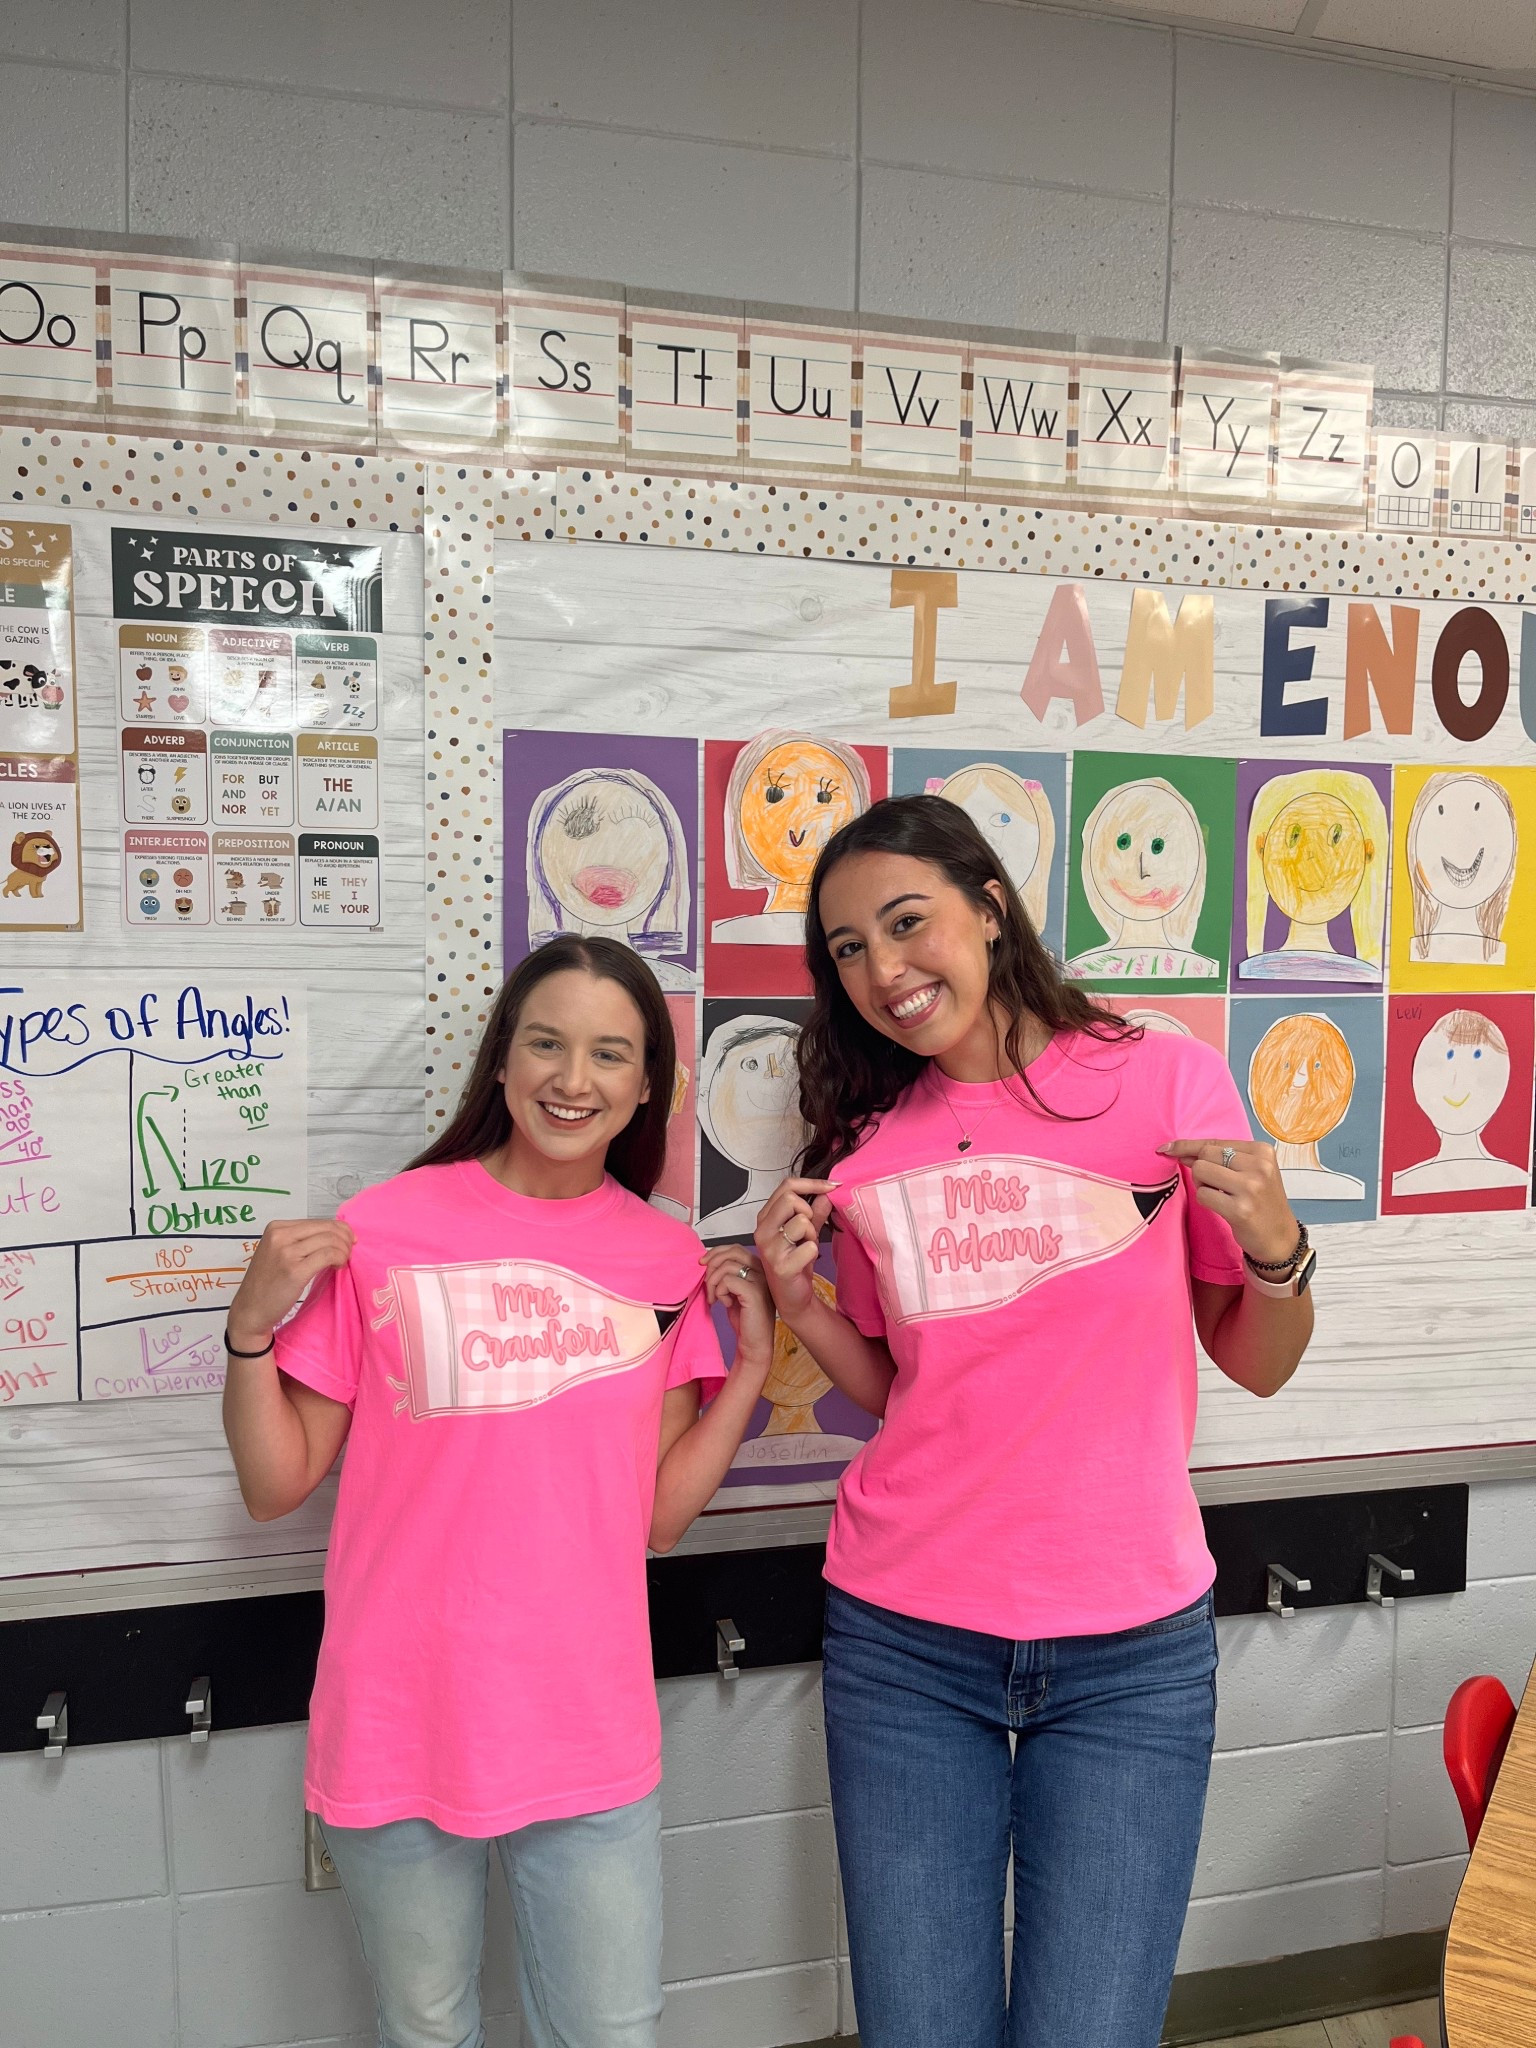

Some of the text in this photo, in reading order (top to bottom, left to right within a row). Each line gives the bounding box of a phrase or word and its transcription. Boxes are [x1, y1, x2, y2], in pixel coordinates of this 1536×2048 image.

[0, 282, 76, 348] Oo
[139, 291, 207, 389] Pp
[261, 305, 355, 404] Qq
[409, 318, 470, 384] Rr
[537, 330, 592, 393] Ss
[657, 345, 713, 407] Tt
[770, 356, 832, 419] Uu
[886, 367, 940, 428] Vv
[983, 377, 1059, 439] Ww
[1095, 388, 1152, 447] Xx
[1201, 394, 1250, 478] Yy
[1300, 406, 1346, 463] Zz
[12, 557, 50, 569] SPECIFIC
[173, 546, 298, 573] PARTS OF
[133, 570, 337, 617] SPEECH
[17, 625, 39, 634] COW
[41, 627, 49, 635] IS
[146, 632, 178, 643] NOUN
[222, 637, 282, 649] ADJECTIVE
[323, 642, 350, 652] VERB
[889, 569, 1536, 743] I AM ENO
[144, 735, 185, 746] ADVERB
[214, 737, 290, 749] CONJUNCTION
[317, 741, 360, 752] ARTICLE
[222, 773, 245, 784] FOR
[258, 775, 279, 785] BUT
[323, 777, 353, 793] THE
[222, 789, 246, 799] AND
[261, 790, 278, 800] OR
[8, 802, 29, 810] LION
[31, 803, 53, 811] LIVES
[55, 803, 67, 811] AT
[221, 804, 247, 815] NOR
[260, 806, 280, 817] YET
[315, 797, 362, 813] A/AN
[12, 812, 28, 820] THE
[129, 836, 207, 847] INTERJECTION
[217, 838, 290, 849] PREPOSITION
[313, 840, 364, 851] PRONOUN
[313, 876, 328, 887] HE
[341, 877, 368, 887] THEY
[311, 890, 331, 900] SHE
[351, 891, 358, 900] I
[313, 904, 330, 914] ME
[340, 904, 370, 914] YOUR
[0, 986, 290, 1063] ypes of Angles!
[184, 1062, 265, 1088] Greater
[0, 1080, 25, 1098] ss
[217, 1084, 262, 1101] than
[0, 1177, 60, 1214] ute
[943, 1169, 1030, 1220] Miss
[147, 1204, 256, 1235] Obtuse
[155, 1245, 193, 1268] 180°
[927, 1222, 1063, 1274] Adams
[130, 1273, 215, 1302] Straight
[492, 1282, 570, 1322] Mrs.
[5, 1312, 55, 1343] 90°
[461, 1316, 620, 1372] Crawford
[0, 1362, 57, 1401] ght
